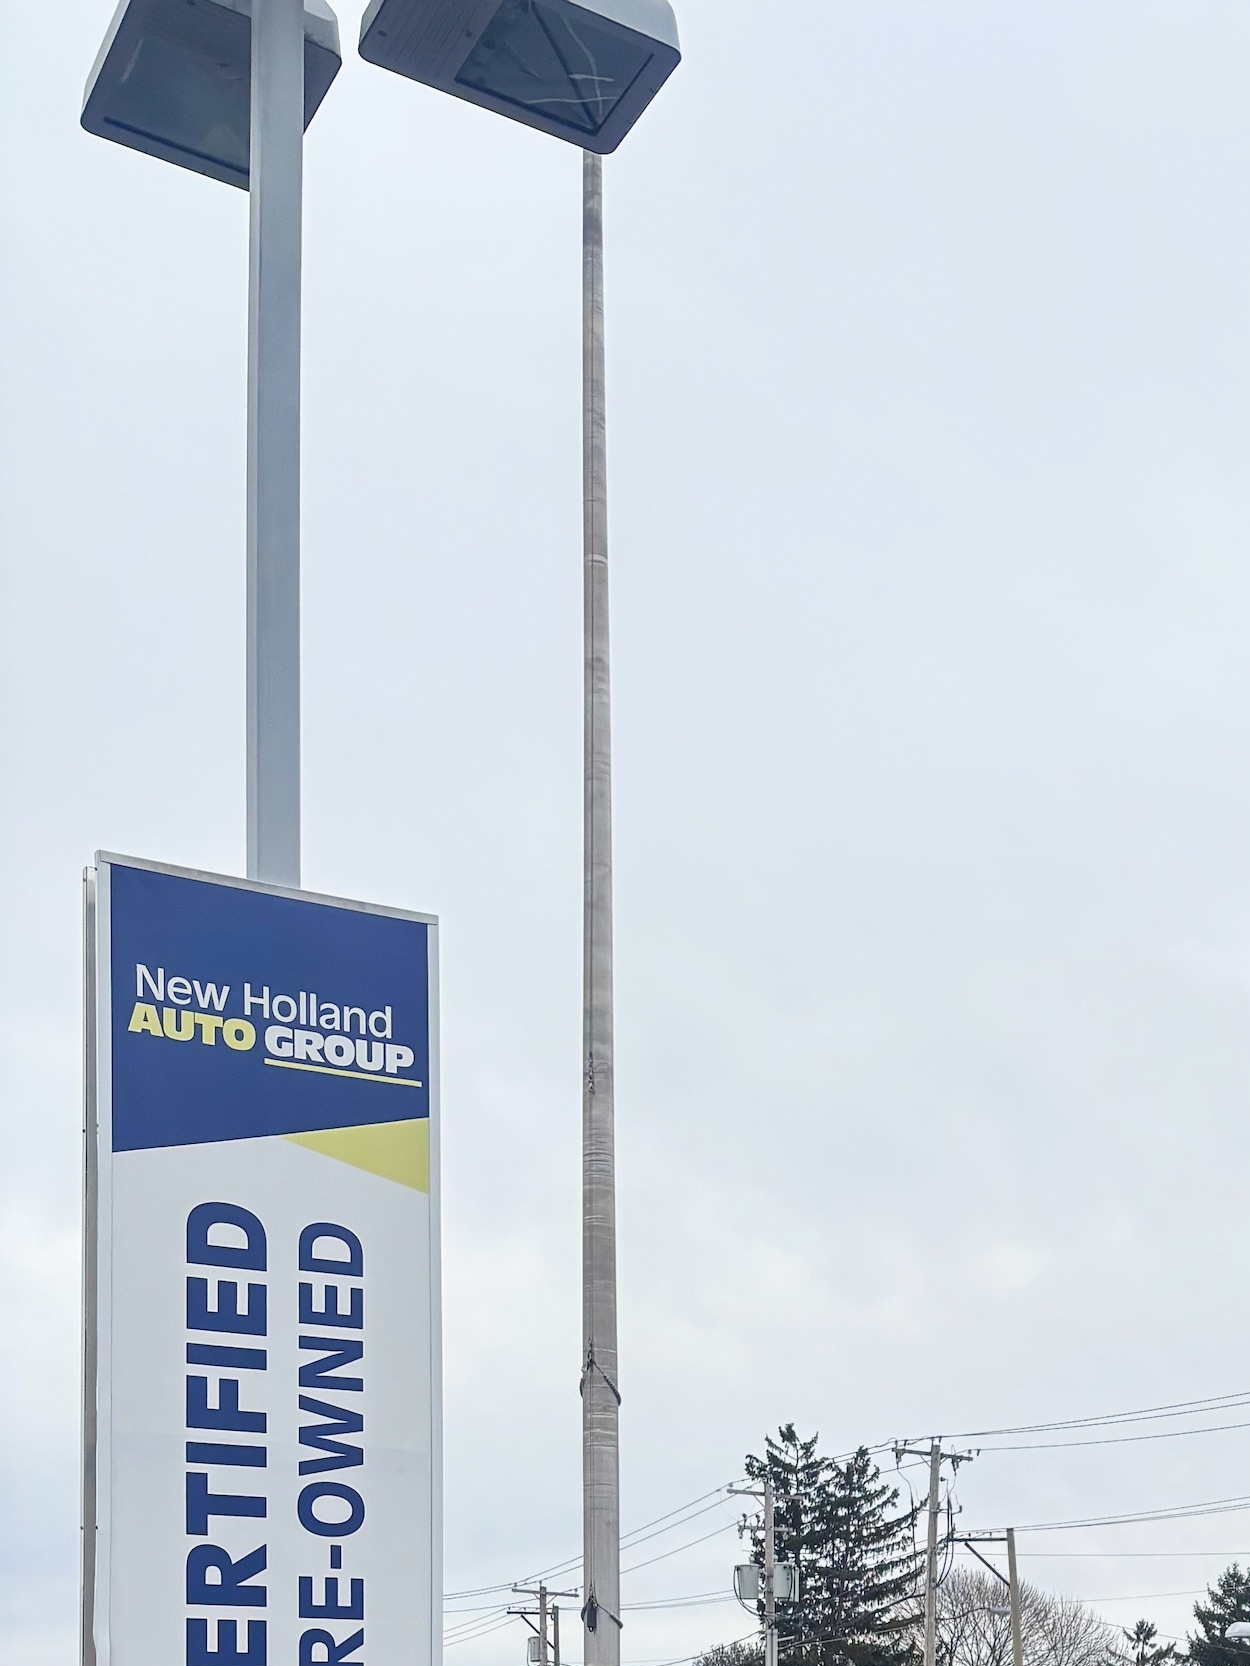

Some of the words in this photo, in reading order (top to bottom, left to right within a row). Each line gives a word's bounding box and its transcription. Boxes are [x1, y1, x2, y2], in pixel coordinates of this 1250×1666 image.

[127, 1002, 257, 1051] AUTO
[264, 1026, 415, 1074] GROUP
[136, 963, 230, 1012] New
[244, 982, 392, 1039] Holland
